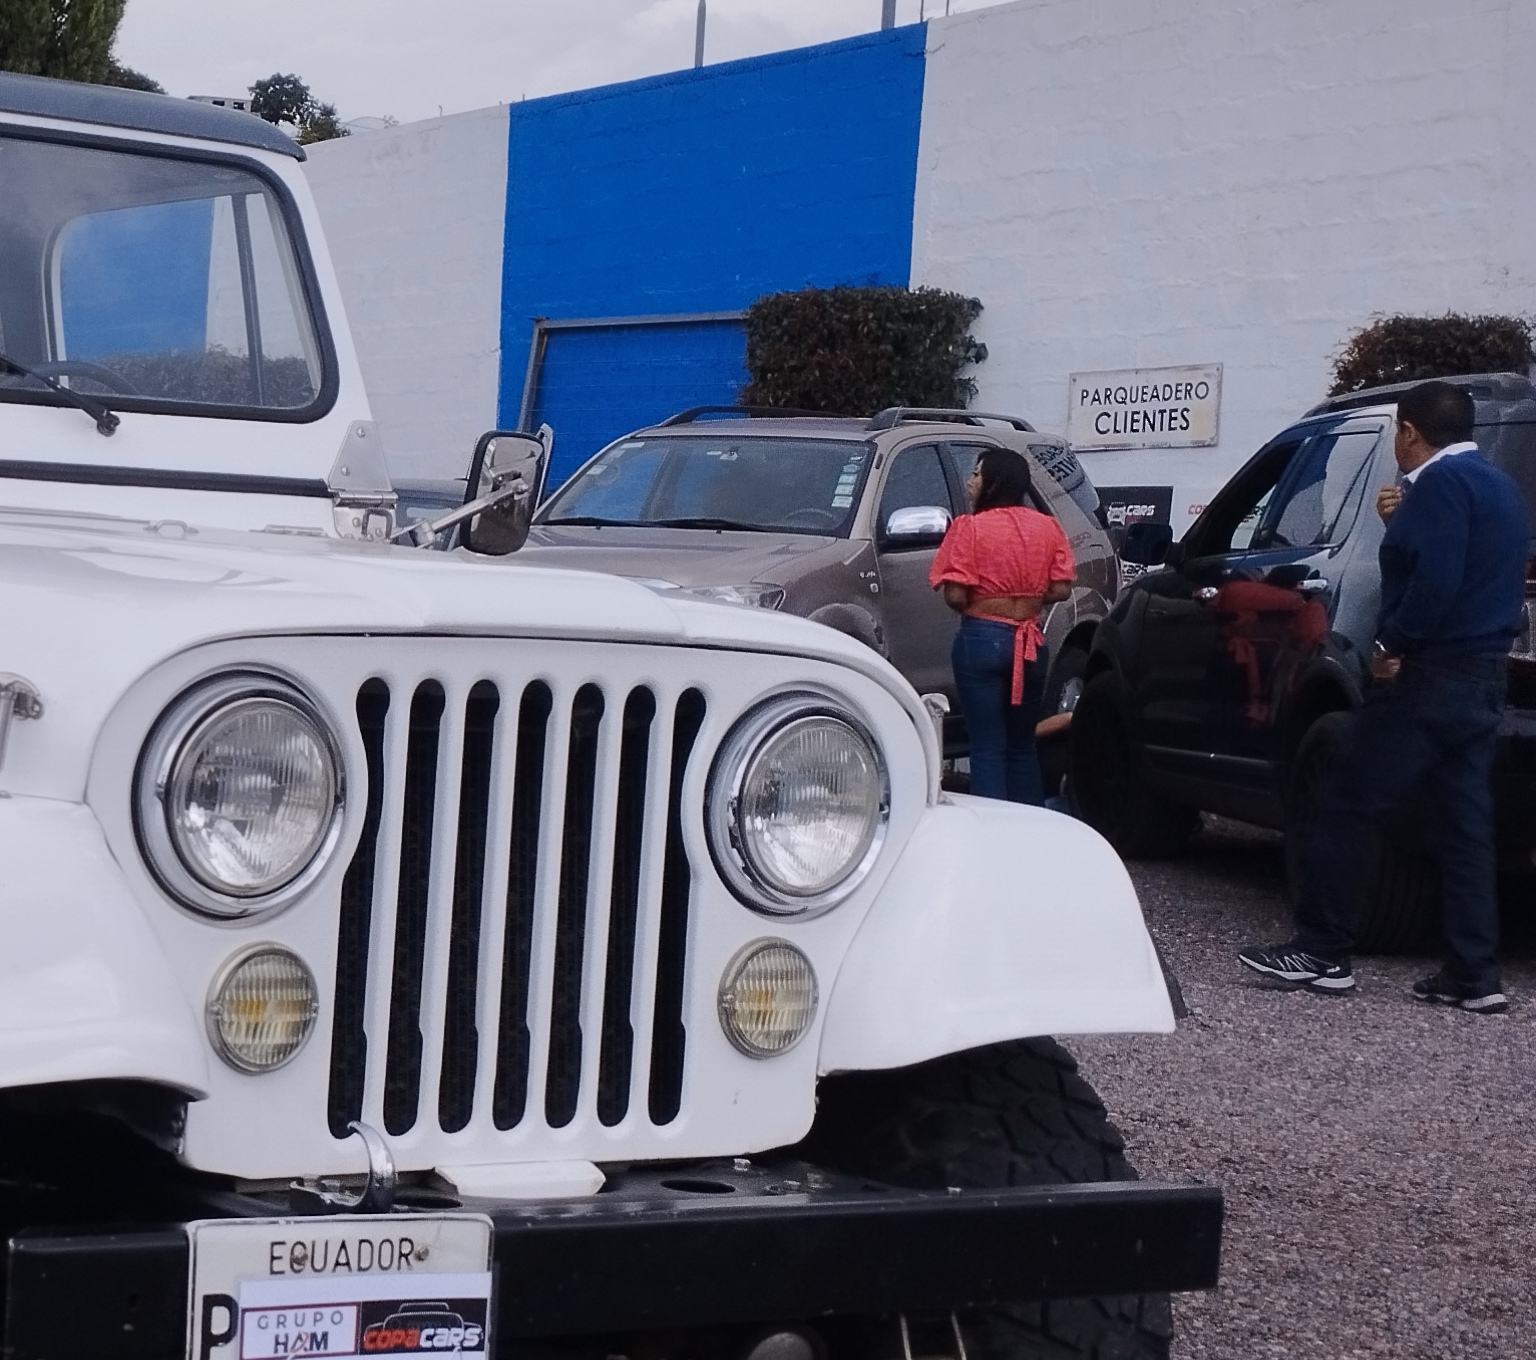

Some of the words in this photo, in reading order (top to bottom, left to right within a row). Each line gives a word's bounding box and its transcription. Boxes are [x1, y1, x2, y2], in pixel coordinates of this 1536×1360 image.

[1080, 381, 1210, 406] PARQUEADERO
[1095, 407, 1190, 435] CLIENTES
[269, 1238, 415, 1275] ECUADOR
[257, 1310, 344, 1330] GRUPO
